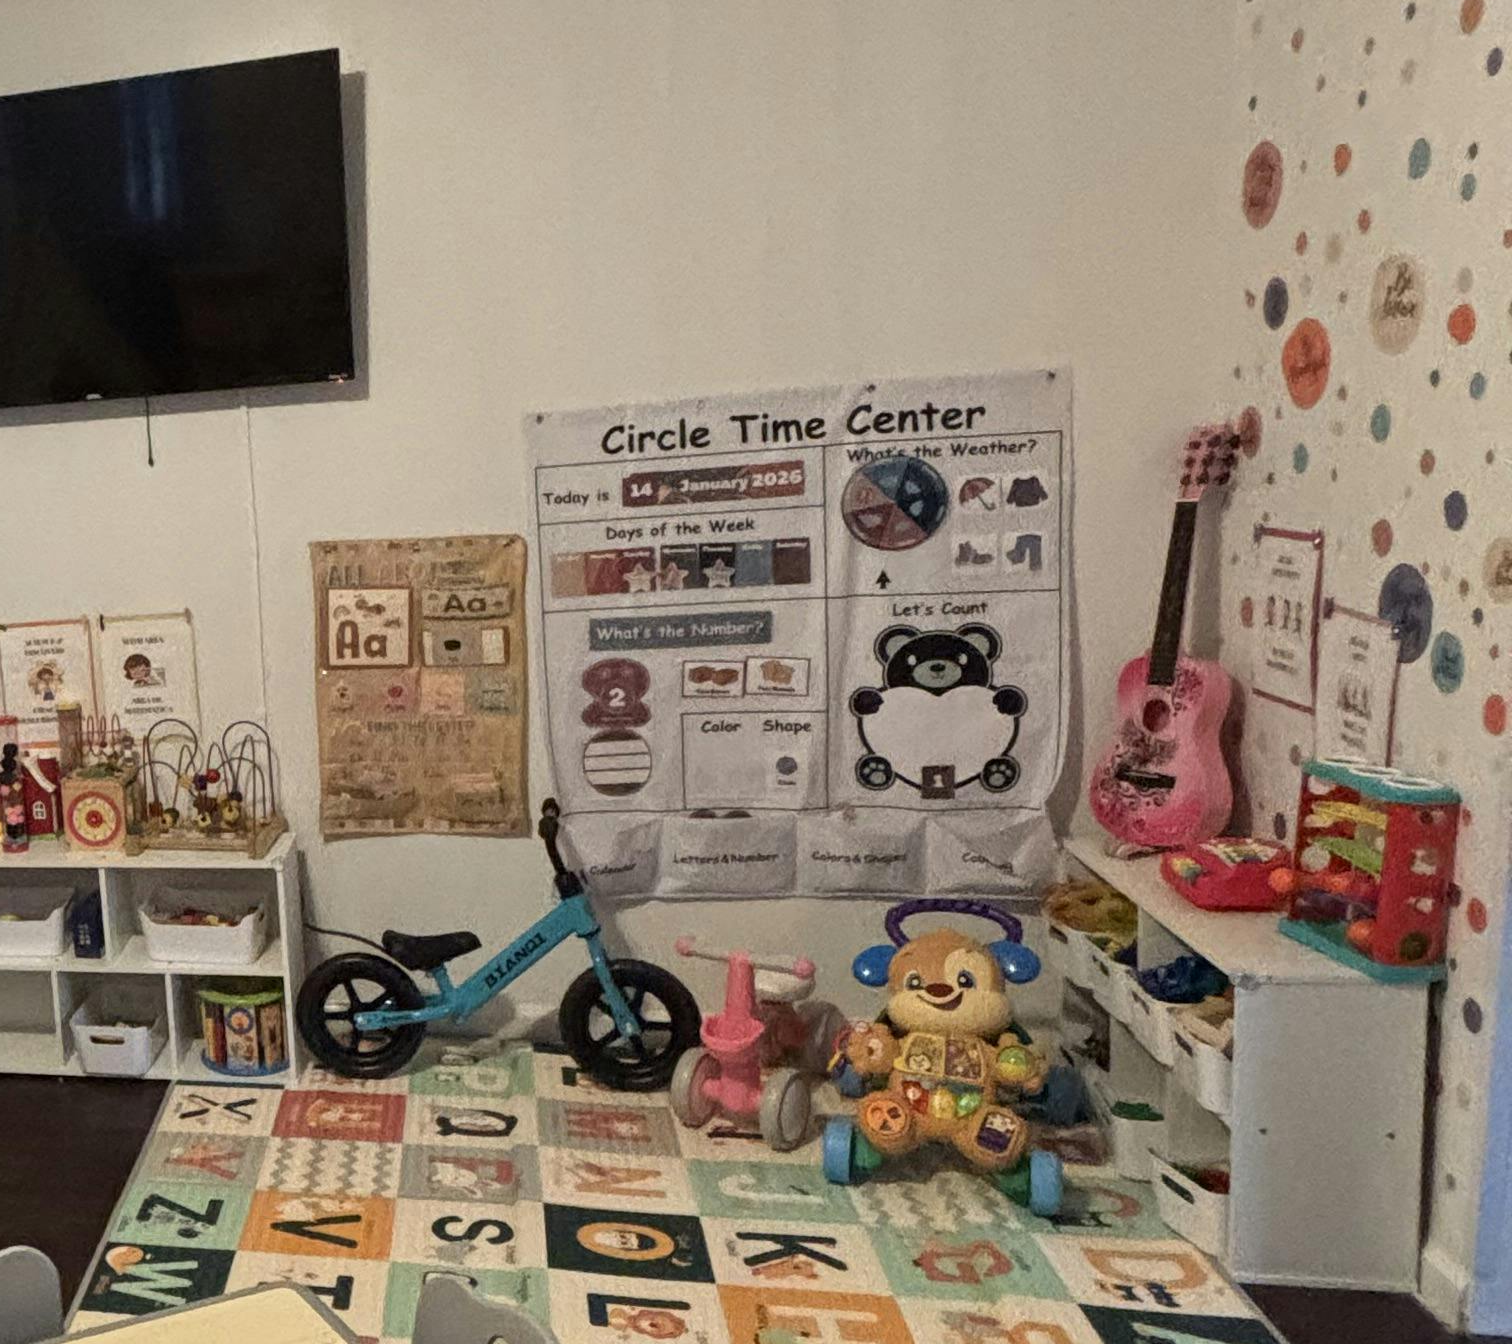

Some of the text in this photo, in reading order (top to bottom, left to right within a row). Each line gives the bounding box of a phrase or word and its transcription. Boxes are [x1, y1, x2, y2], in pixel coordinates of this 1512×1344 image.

[601, 402, 986, 455] Circle Time Center
[846, 439, 1037, 462] What's the Weather?
[543, 491, 609, 505] Today is
[630, 482, 653, 497] 14
[679, 475, 749, 493] January
[606, 517, 755, 541] Days of the Week
[443, 594, 487, 614] Aa
[892, 602, 988, 617] Let's Count
[336, 620, 388, 660] Aa
[596, 622, 764, 640] What's the Number?
[608, 687, 626, 707] 2
[701, 719, 811, 735] Color Shape
[933, 775, 944, 788] 1
[179, 1093, 257, 1120] X
[136, 1193, 225, 1226] Z
[270, 1214, 362, 1249] V
[431, 1215, 514, 1245] S
[576, 1222, 675, 1261] O
[736, 1232, 848, 1272] K
[916, 1238, 1014, 1285] G
[110, 1260, 198, 1306] W
[1081, 1247, 1208, 1291] D
[588, 1293, 691, 1327] L
